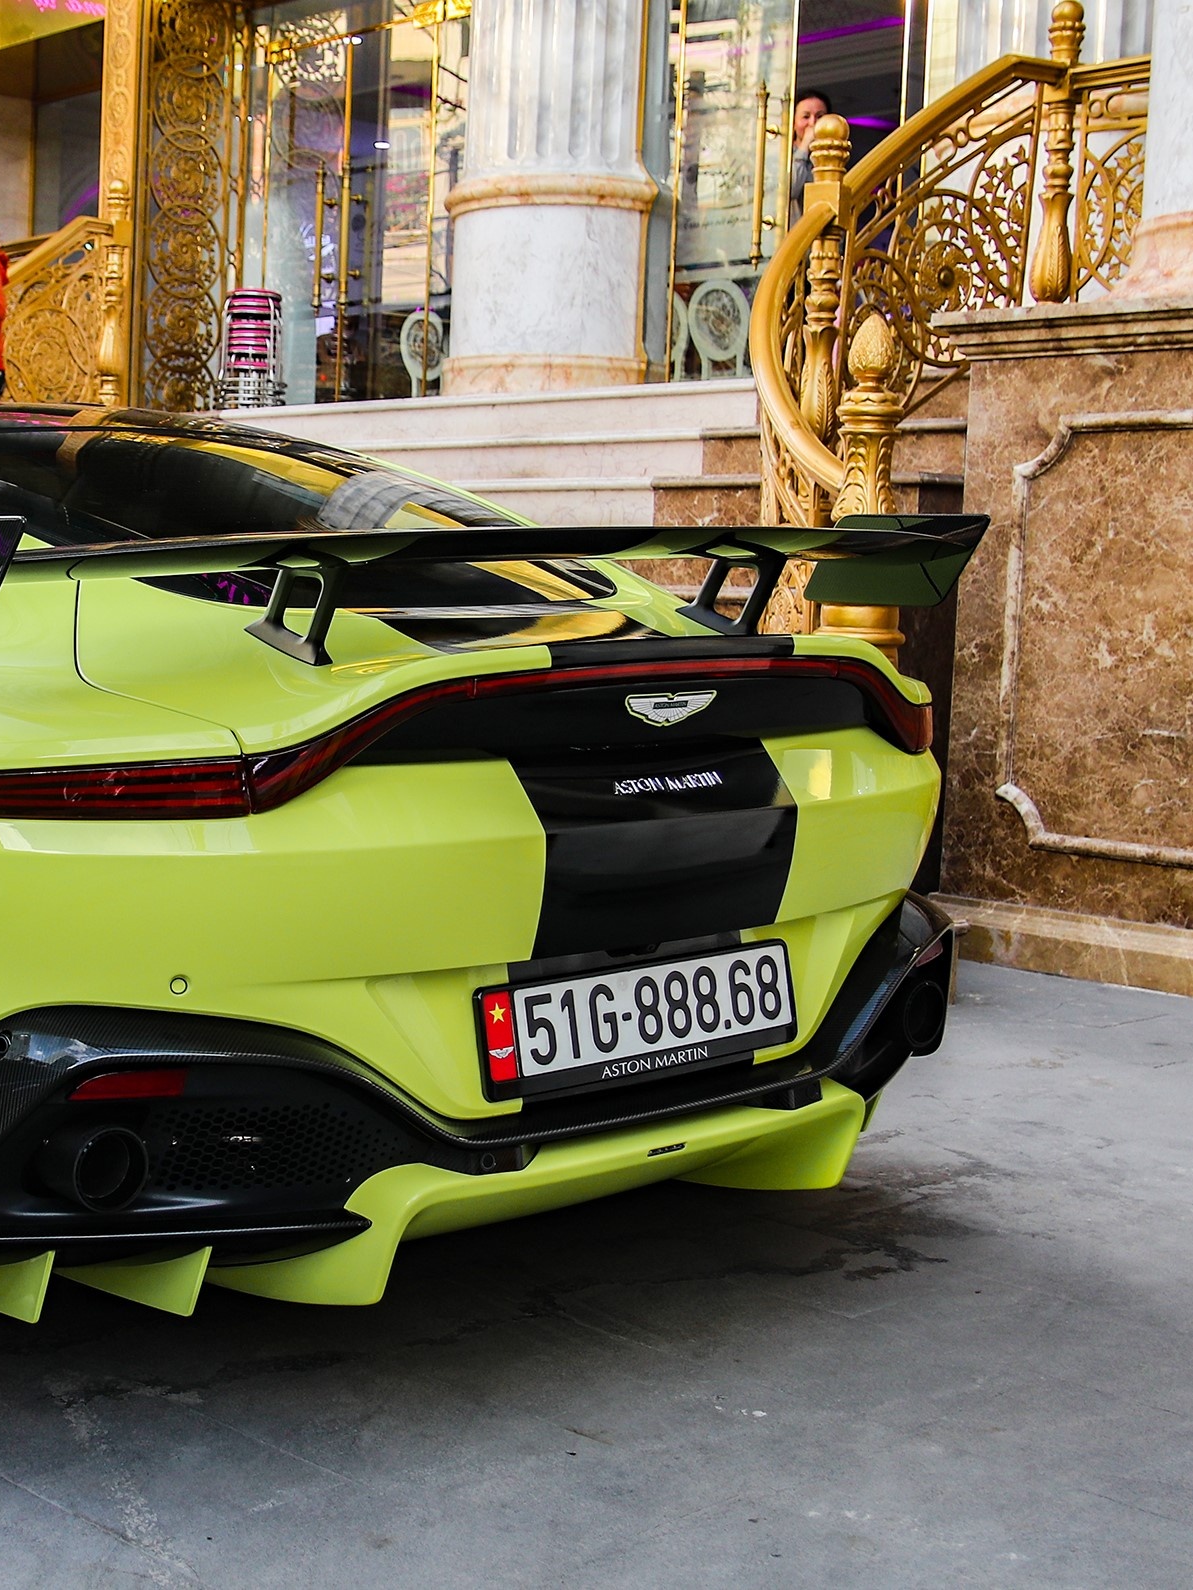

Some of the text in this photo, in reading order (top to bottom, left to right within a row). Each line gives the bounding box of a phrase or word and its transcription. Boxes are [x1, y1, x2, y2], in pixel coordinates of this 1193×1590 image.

[614, 771, 723, 795] ASTON MARTIN
[524, 954, 782, 1066] 51G-888.68
[601, 1045, 708, 1079] ASTON MARTIN
